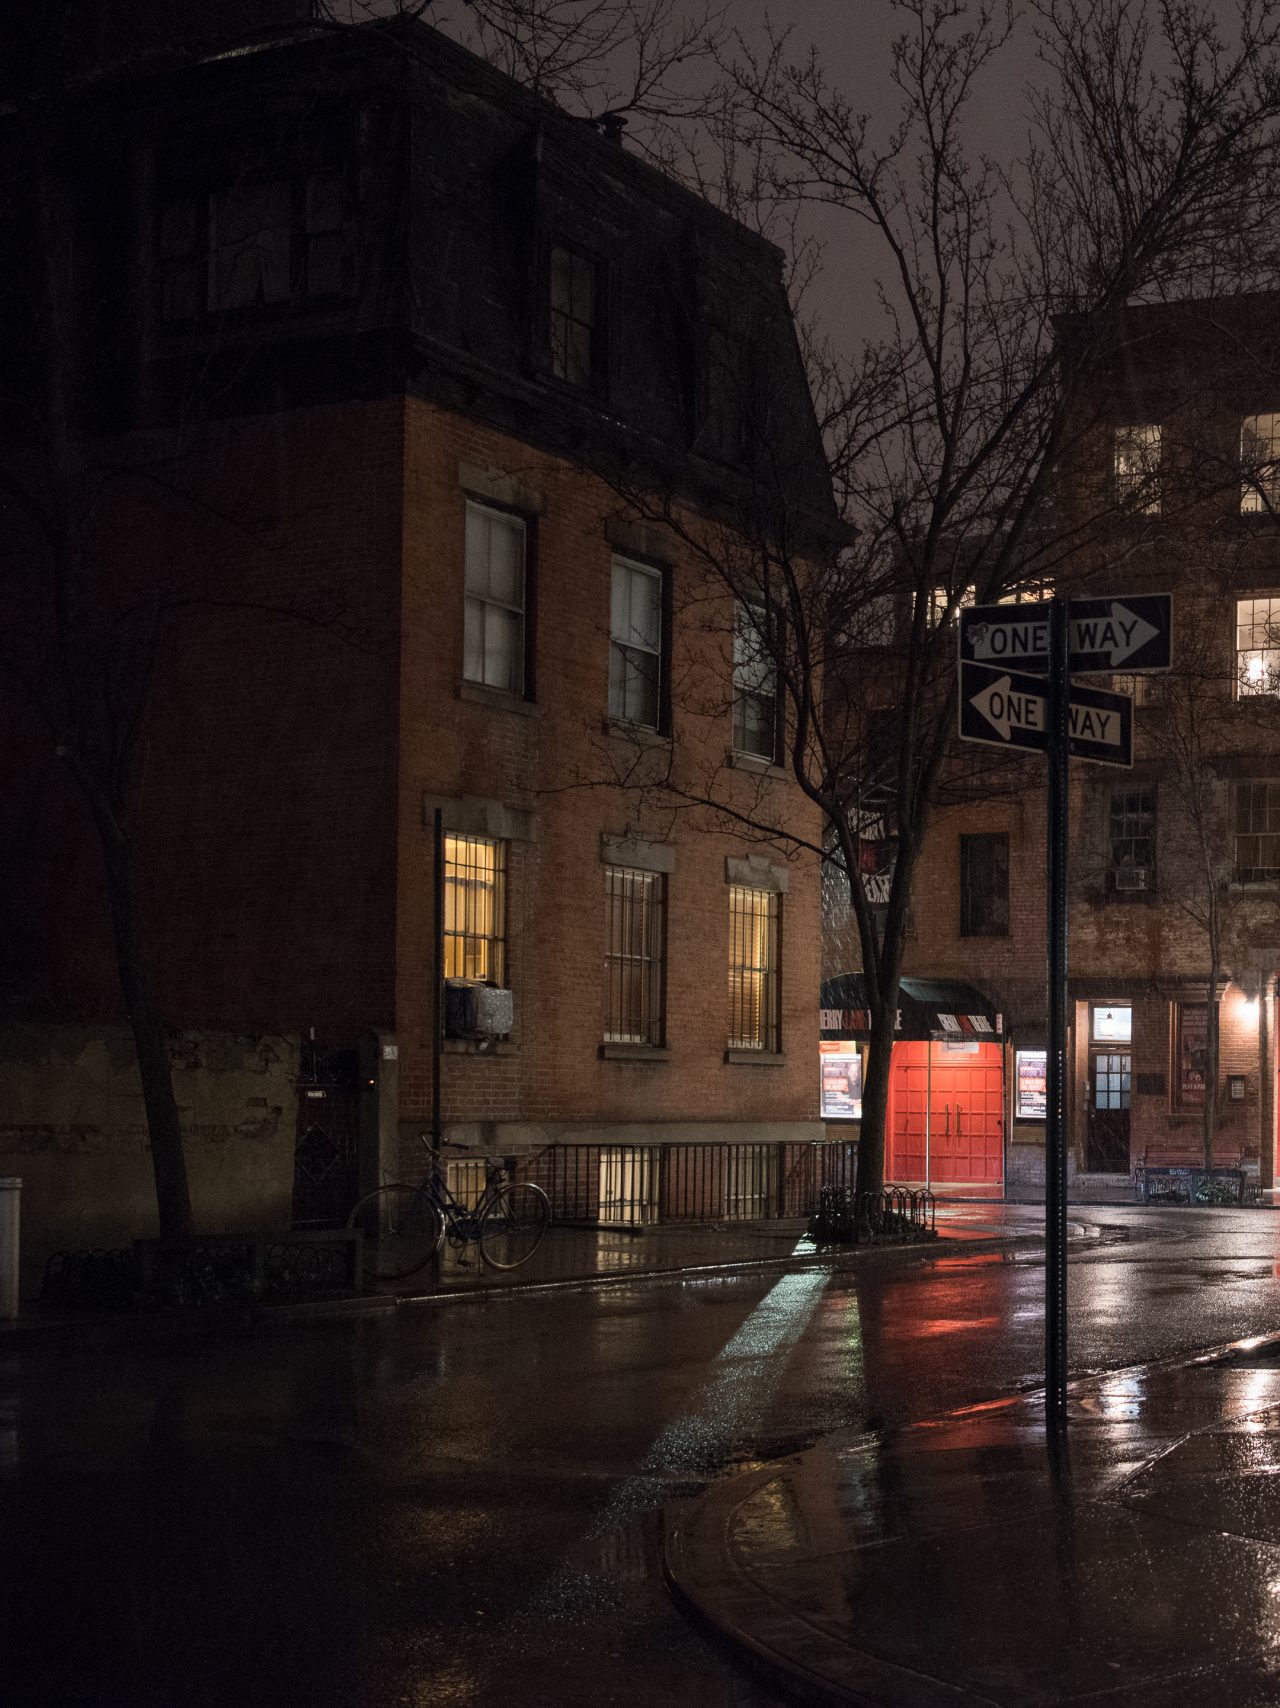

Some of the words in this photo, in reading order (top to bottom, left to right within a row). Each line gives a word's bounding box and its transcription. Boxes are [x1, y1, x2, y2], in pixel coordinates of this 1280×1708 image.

[990, 626, 1048, 655] ONE
[1077, 620, 1139, 650] WAY
[989, 691, 1037, 727] ONE
